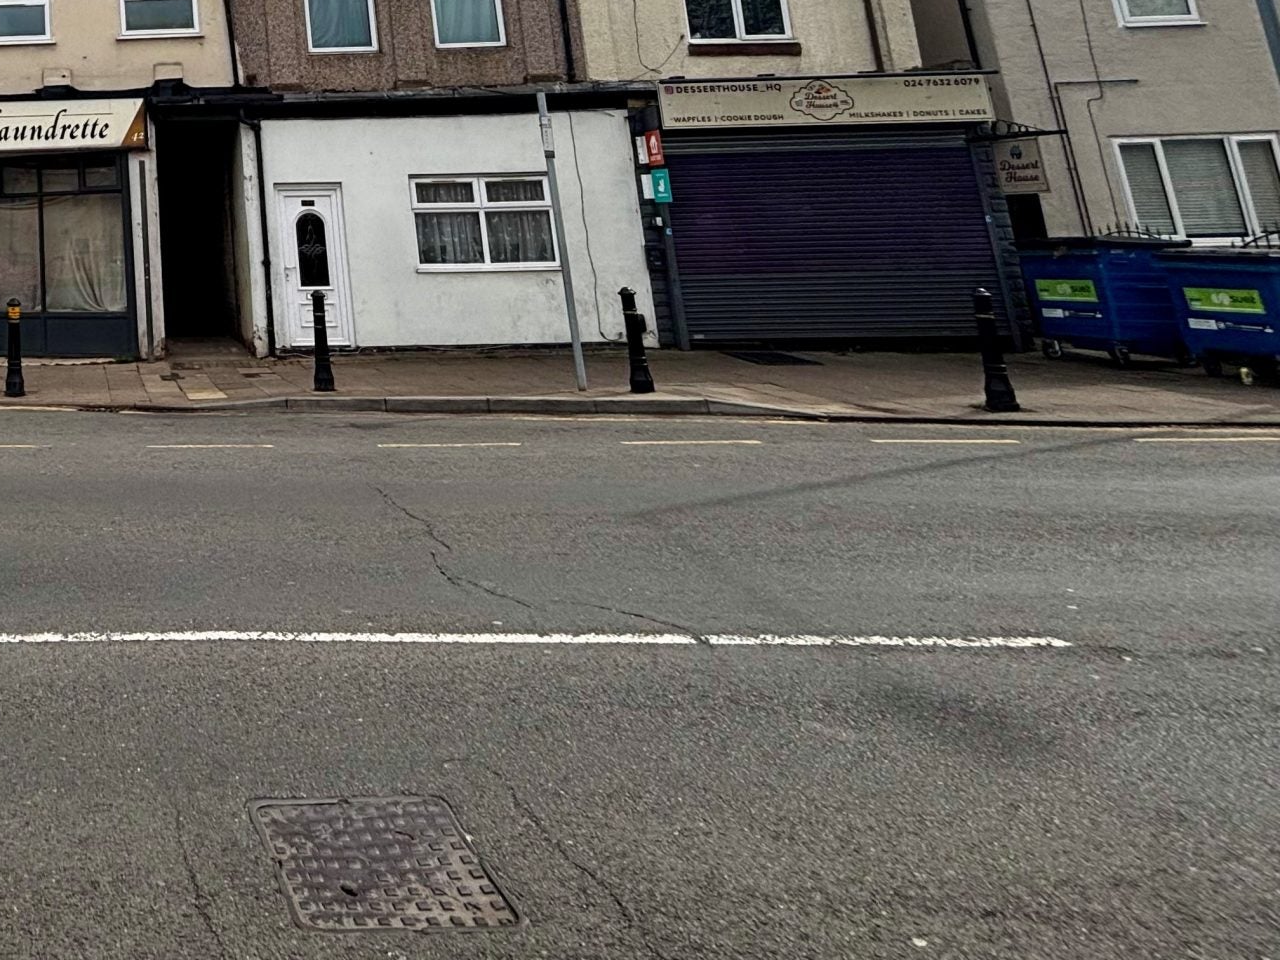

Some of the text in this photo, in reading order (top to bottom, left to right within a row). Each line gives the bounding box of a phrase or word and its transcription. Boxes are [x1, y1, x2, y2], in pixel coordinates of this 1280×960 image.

[904, 79, 923, 87] 024
[676, 83, 782, 94] DESSERTHOUSE_HQ
[804, 92, 837, 100] Dessert
[673, 115, 712, 123] WAFFLES
[131, 132, 144, 142] 42
[1000, 160, 1040, 171] Dessert
[1005, 171, 1039, 183] House
